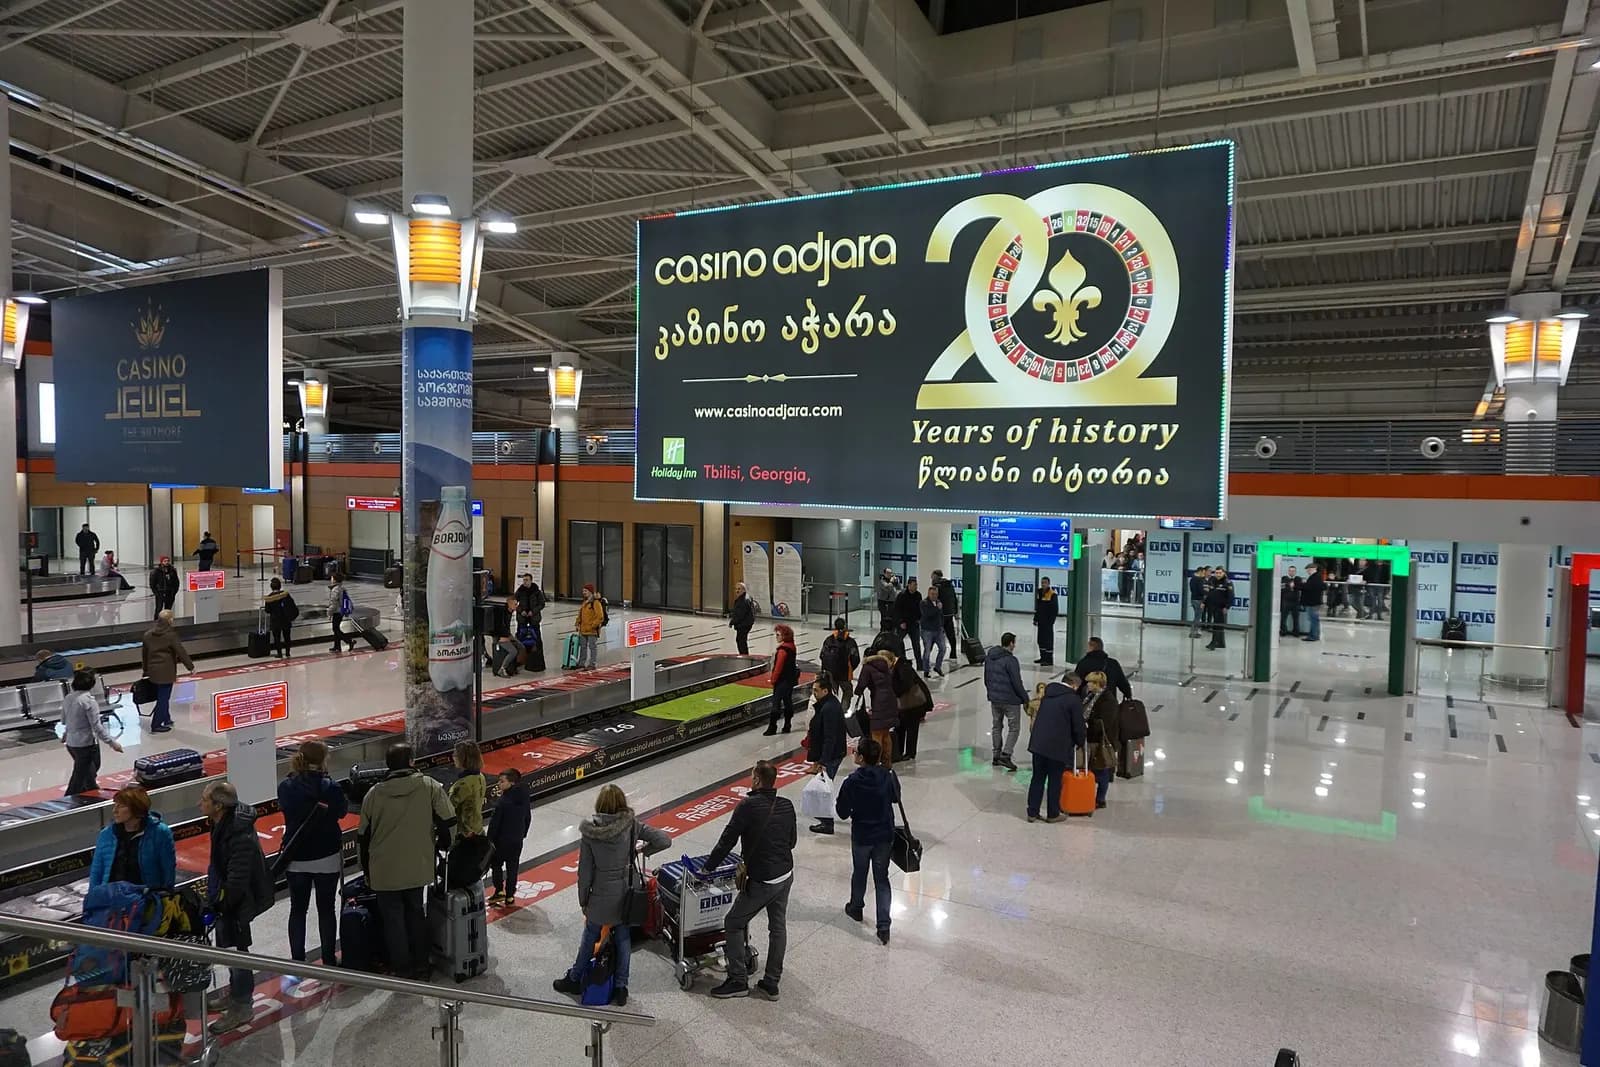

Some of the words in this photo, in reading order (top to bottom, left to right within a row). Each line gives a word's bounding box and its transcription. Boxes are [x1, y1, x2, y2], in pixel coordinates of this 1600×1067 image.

[1052, 217, 1063, 229] 26
[1077, 216, 1088, 226] 32
[1089, 216, 1099, 228] 15
[1100, 220, 1111, 233] 19
[1119, 234, 1131, 247] 21
[654, 248, 767, 286] casino
[772, 231, 897, 287] adjara
[1132, 256, 1144, 269] 25
[1136, 271, 1147, 280] 17
[994, 281, 1004, 291] 18
[1137, 281, 1148, 294] 34
[992, 293, 1002, 304] 22
[1133, 309, 1144, 320] 27
[654, 304, 766, 360] კაზინო
[781, 294, 897, 354] აჭარა
[1127, 322, 1140, 333] 13
[1121, 332, 1133, 346] 36
[1112, 343, 1123, 354] 11
[1102, 351, 1114, 362] 30
[117, 353, 186, 381] CASINO
[1031, 361, 1041, 372] 16
[1068, 367, 1077, 377] 10
[1080, 363, 1090, 375] 23
[105, 384, 201, 420] JEWEL
[694, 404, 842, 420] www.casinoadjara.com
[911, 419, 994, 444] Years
[1006, 418, 1042, 450] of
[1049, 417, 1179, 451] history
[651, 466, 683, 481] Holiday
[683, 466, 697, 479] Inn
[704, 464, 745, 482] Tbilisi,
[750, 465, 811, 485] Georgia,
[918, 455, 1020, 489] წლიანი
[1032, 456, 1170, 493] ისტორია
[1150, 541, 1181, 552] TAV
[1192, 542, 1224, 553] TAV
[1155, 569, 1173, 577] EXIT
[1006, 582, 1033, 592] TAV
[1148, 592, 1179, 603] TAV
[604, 723, 635, 734] 26
[700, 893, 732, 909] TAV
